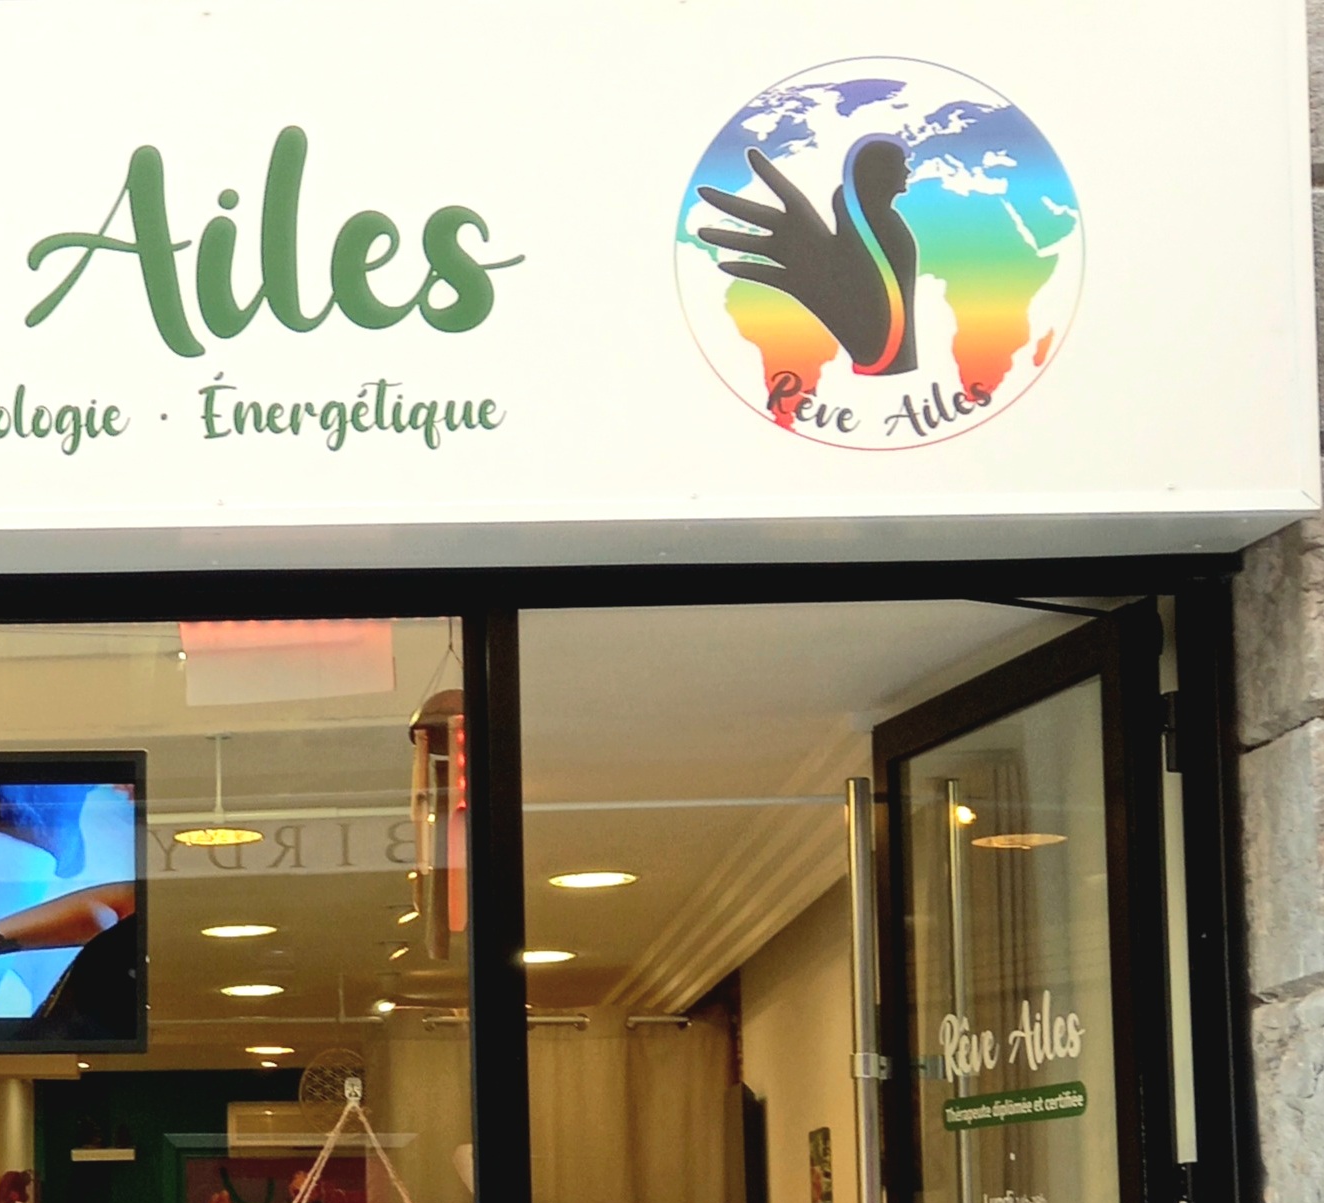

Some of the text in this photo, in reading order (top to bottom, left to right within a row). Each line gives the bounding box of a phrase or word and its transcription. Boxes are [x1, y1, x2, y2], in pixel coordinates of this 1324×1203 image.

[25, 125, 525, 358] Ailes
[198, 371, 505, 452] Énergétique
[766, 370, 993, 437] Rêve Ailes
[940, 989, 1086, 1083] Rêve Ailes
[1034, 1096, 1044, 1112] et
[1044, 1090, 1085, 1111] certifiée
